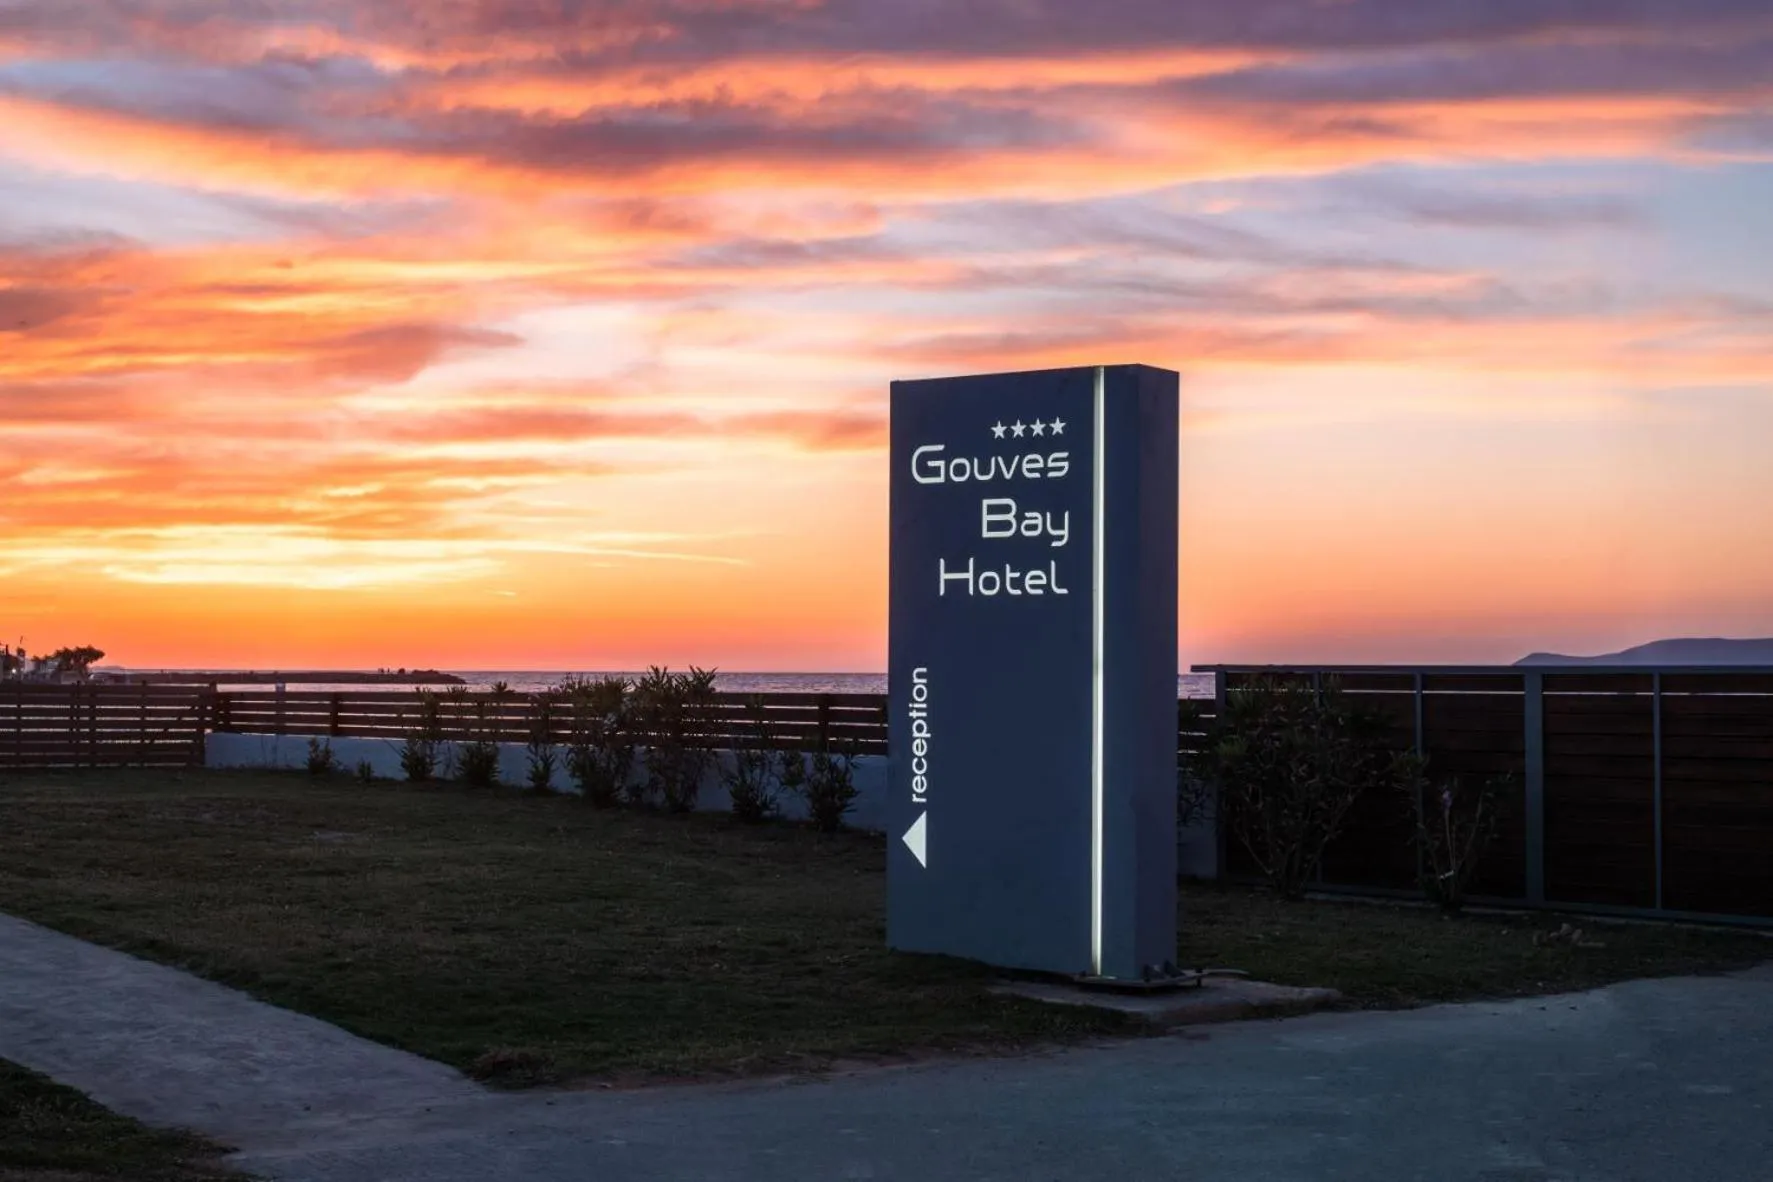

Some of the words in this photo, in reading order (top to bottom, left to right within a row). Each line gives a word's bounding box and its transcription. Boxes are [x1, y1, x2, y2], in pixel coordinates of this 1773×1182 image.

[911, 444, 1070, 484] Gouves
[981, 498, 1070, 547] Bay
[939, 557, 1069, 597] Hotel
[908, 667, 932, 803] reception
